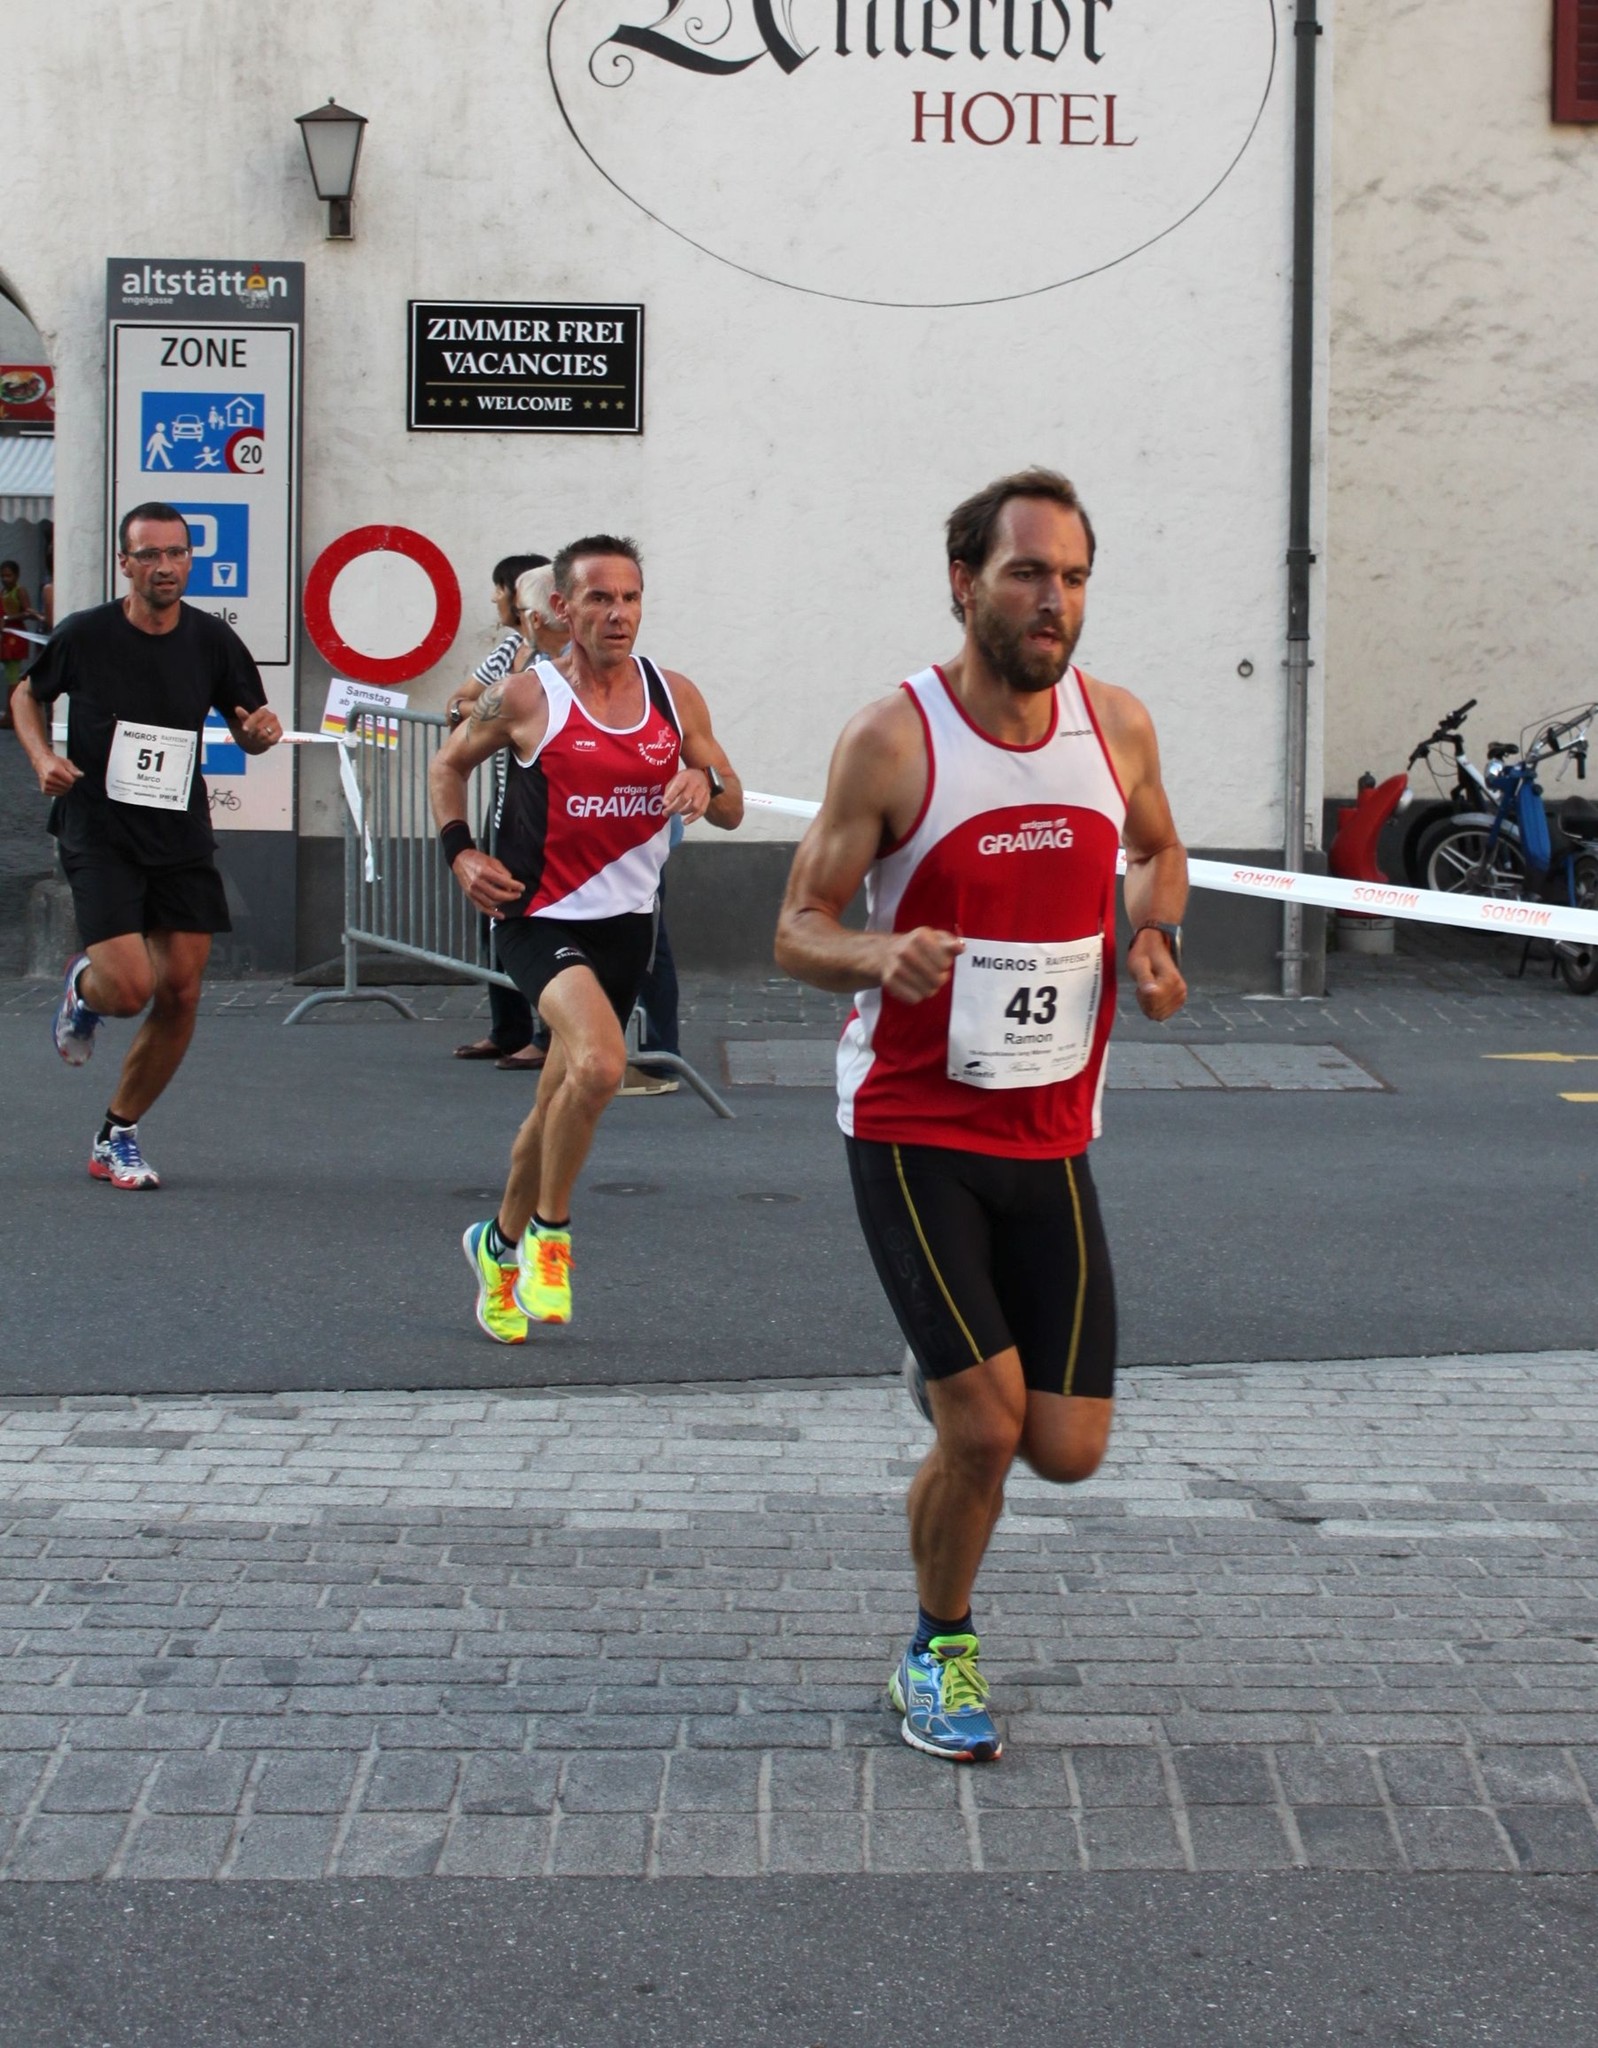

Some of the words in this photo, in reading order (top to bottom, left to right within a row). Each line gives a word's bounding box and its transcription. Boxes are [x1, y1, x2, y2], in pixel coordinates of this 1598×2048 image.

[911, 90, 1138, 146] HOTEL
[122, 265, 288, 297] altstätten
[122, 296, 174, 307] engelgasse
[427, 318, 552, 342] ZIMMER
[557, 321, 624, 344] FREI
[161, 337, 247, 368] ZONE
[442, 352, 608, 377] VACANCIES
[477, 396, 573, 412] WELCOME
[240, 445, 262, 464] 20
[346, 686, 391, 706] Samstag
[123, 730, 158, 742] MIGROS
[137, 748, 165, 772] 51
[137, 773, 161, 783] Marco
[613, 785, 648, 795] erdgas
[566, 795, 665, 817] GRAVAG
[978, 828, 1073, 855] GRAVAG
[1232, 870, 1296, 890] MIGROS
[1352, 887, 1421, 908] MIGROS
[1480, 904, 1552, 926] MIGROS
[972, 956, 1037, 971] MIGROS
[1005, 986, 1058, 1025] 43
[1004, 1032, 1053, 1045] Ramon
